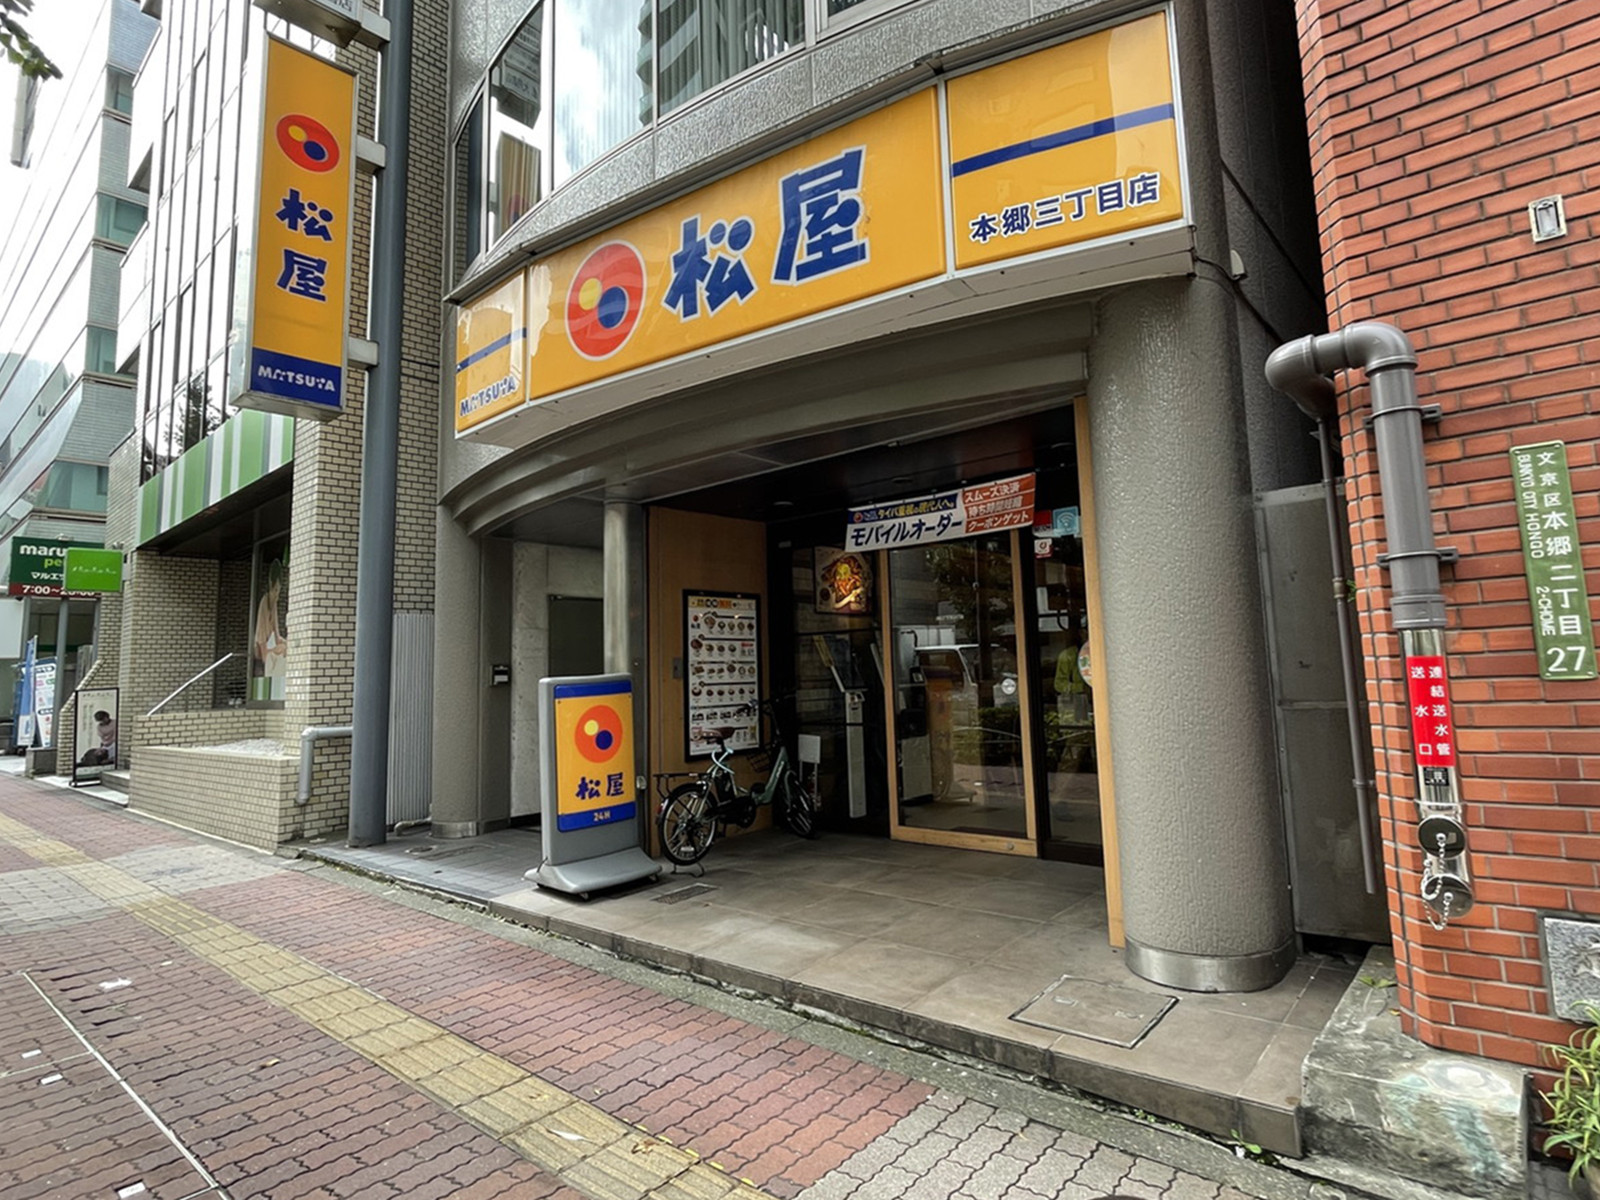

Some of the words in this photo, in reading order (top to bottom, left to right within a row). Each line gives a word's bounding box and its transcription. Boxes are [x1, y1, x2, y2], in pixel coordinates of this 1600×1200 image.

[969, 171, 1160, 244] 本郷三丁目店
[275, 187, 334, 302] 松屋
[661, 146, 869, 321] 松屋
[257, 365, 336, 392] MATSUYA
[460, 375, 517, 417] MATSUYA
[1517, 453, 1534, 488] BUNKYO
[964, 481, 1020, 503] スムーズ決済
[1523, 491, 1537, 509] CITY
[851, 513, 962, 547] モバイルオーダー
[968, 511, 1029, 532] クーポンゲット
[1525, 513, 1545, 559] HONGO
[1546, 646, 1587, 673] 27
[1411, 665, 1433, 756] 送水口
[1429, 665, 1451, 756] 連結送水管
[575, 772, 625, 801] 松屋
